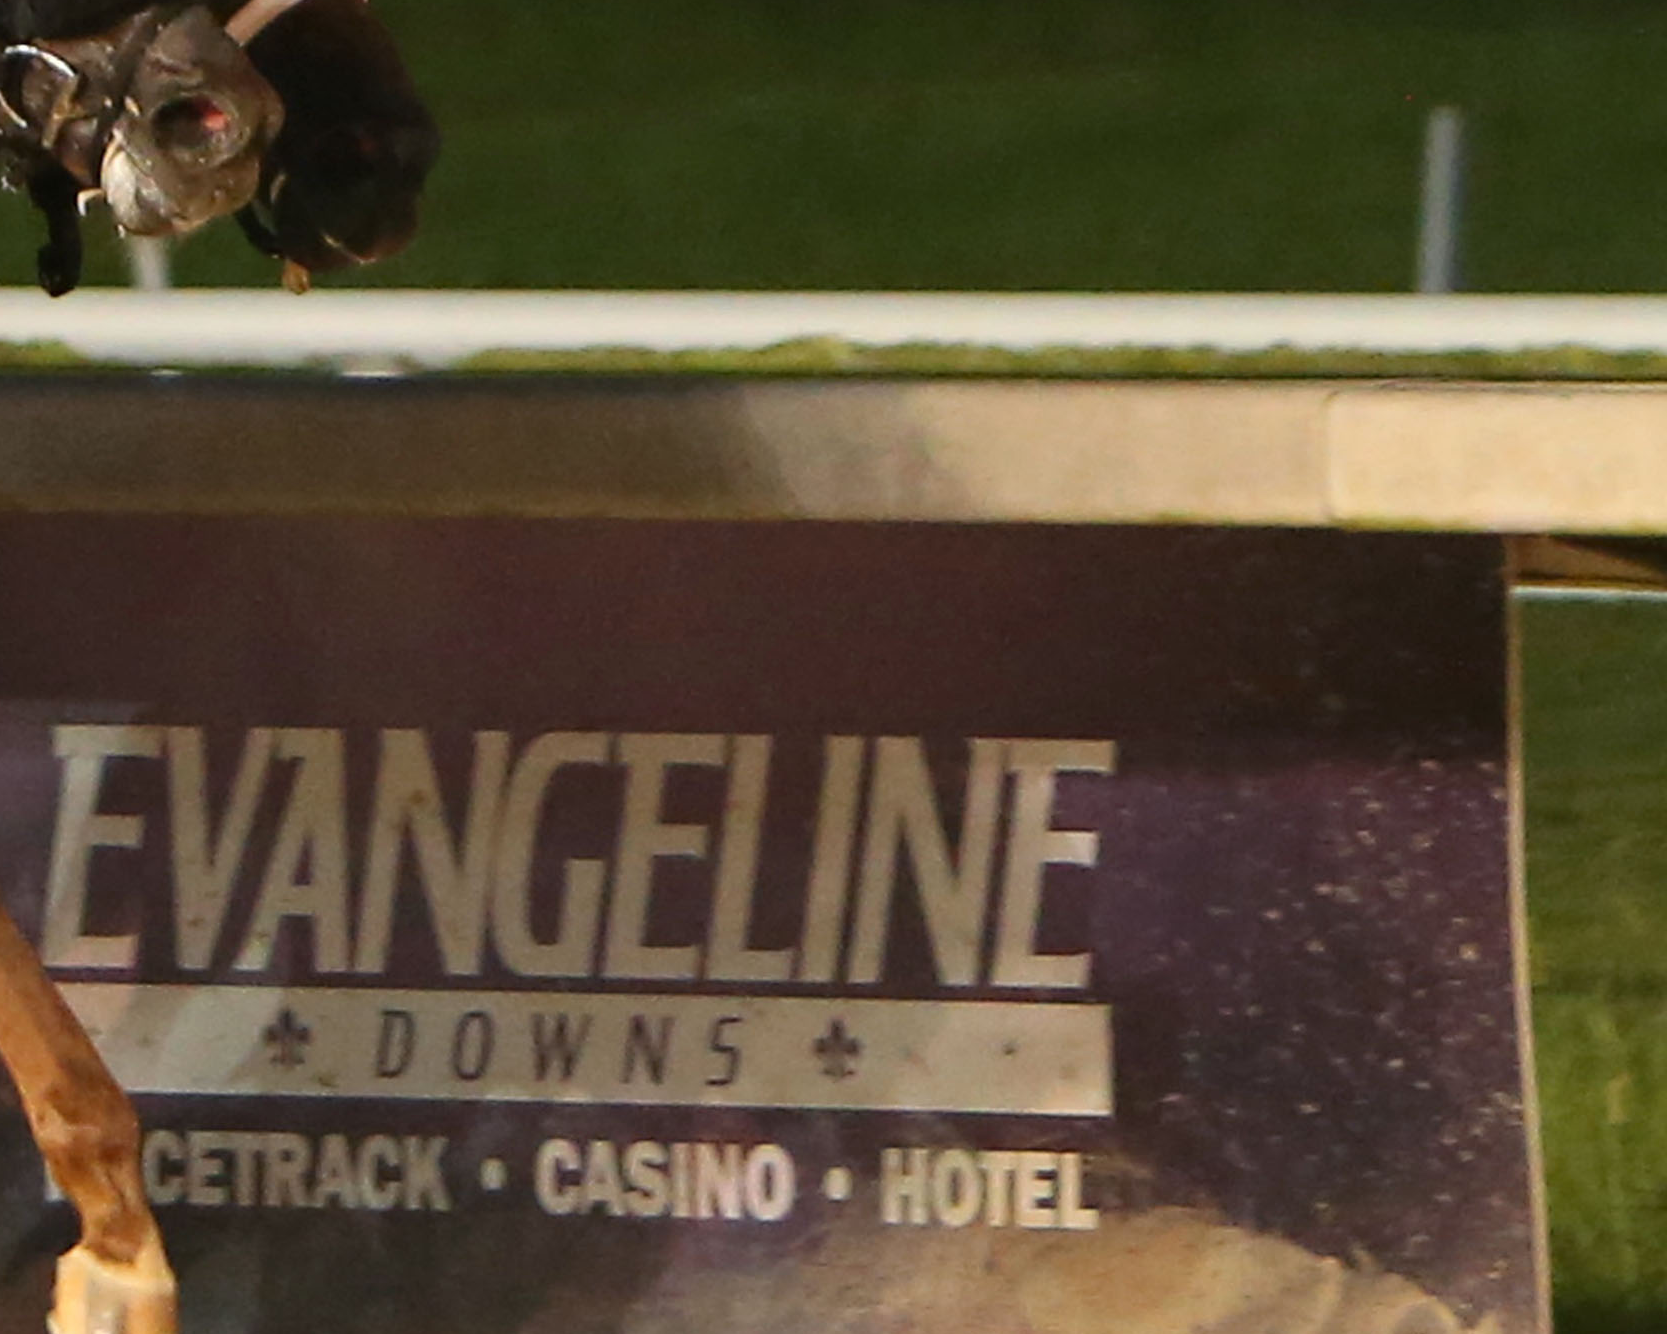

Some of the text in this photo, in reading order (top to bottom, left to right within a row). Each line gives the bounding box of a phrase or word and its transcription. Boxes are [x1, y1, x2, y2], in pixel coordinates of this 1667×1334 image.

[41, 723, 1118, 989] EVANGELINE
[375, 1009, 745, 1087] DOWNS
[44, 1128, 1101, 1231] CETRACK CASINO HOTEL
